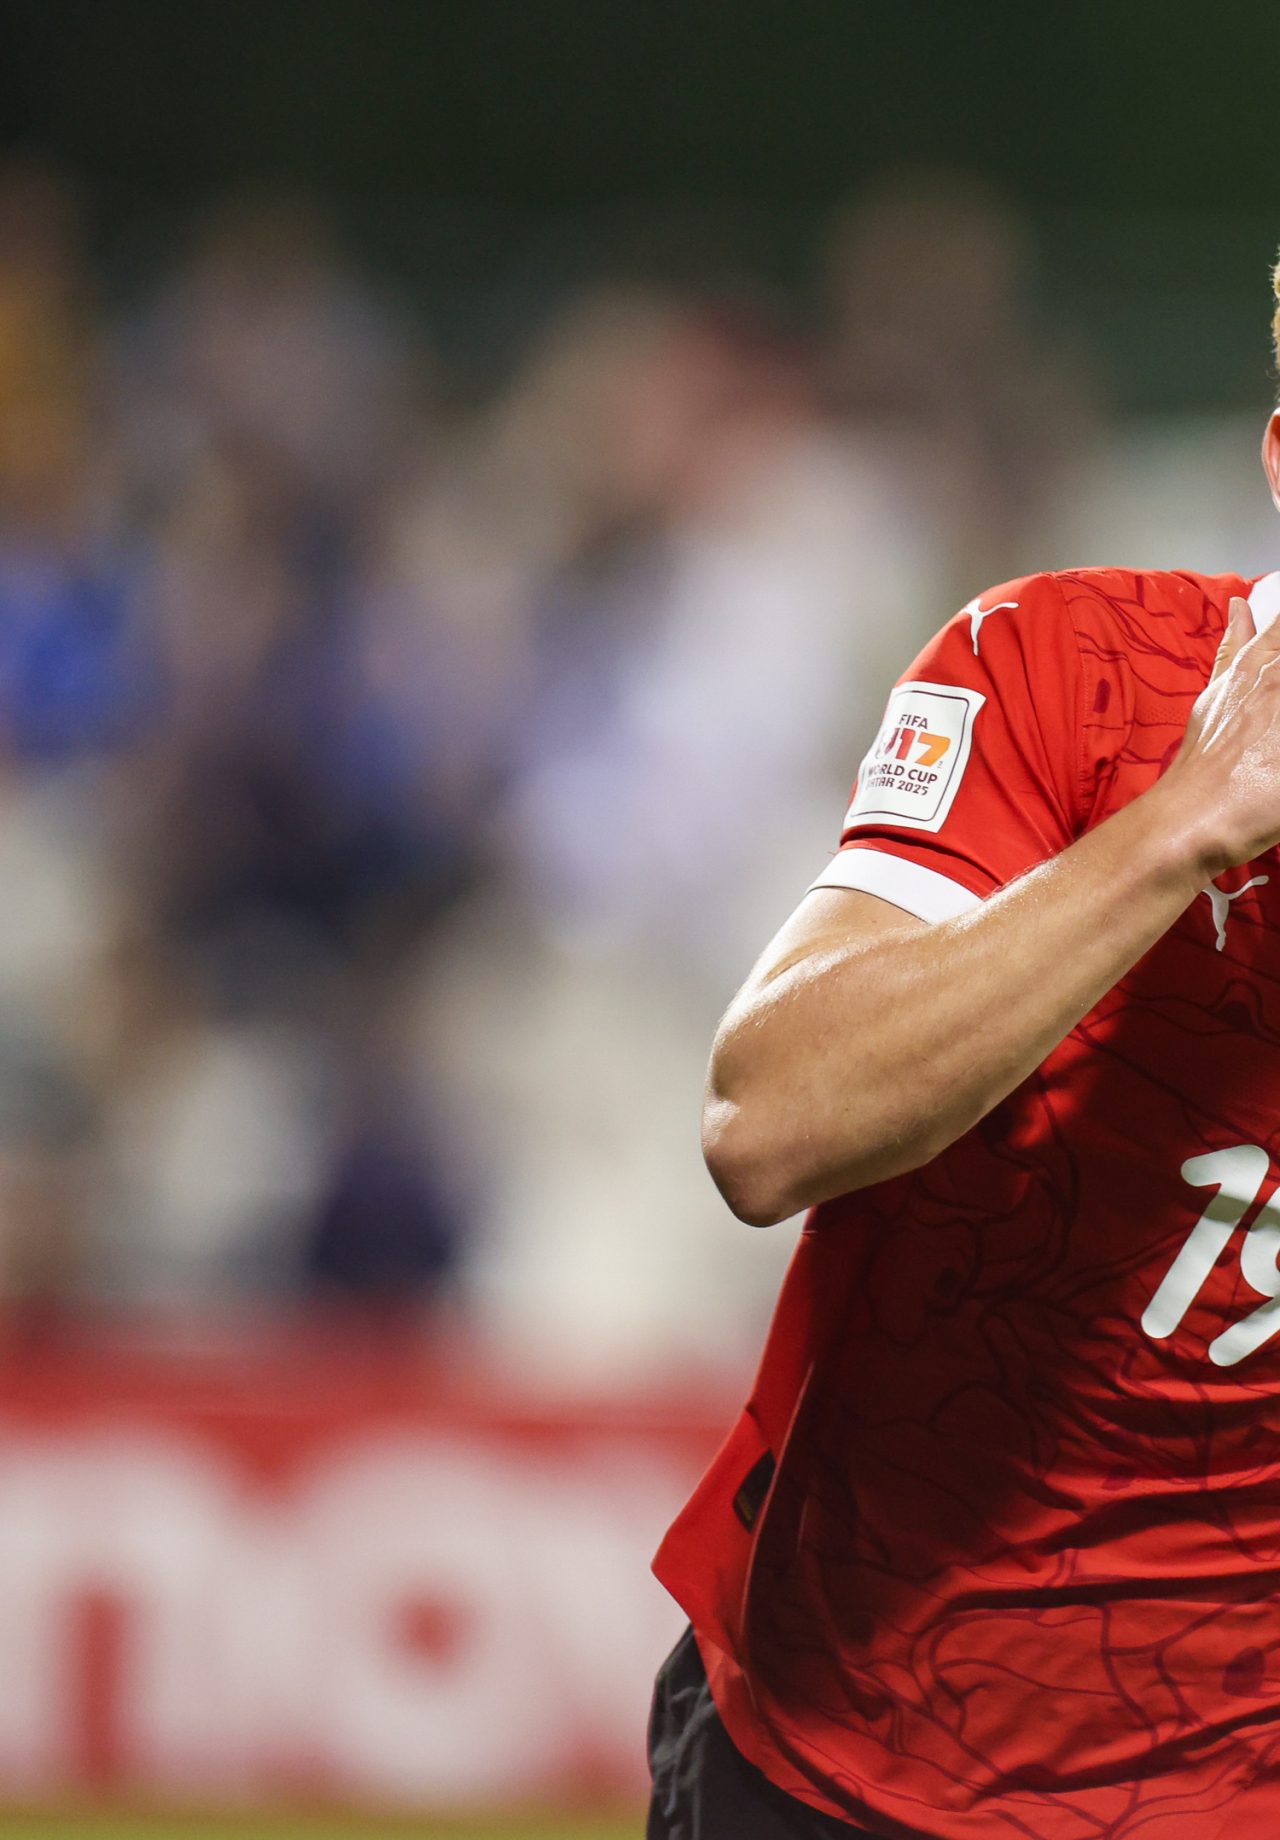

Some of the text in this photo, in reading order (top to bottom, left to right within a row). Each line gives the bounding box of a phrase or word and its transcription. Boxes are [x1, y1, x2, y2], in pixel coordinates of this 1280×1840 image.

[899, 714, 928, 729] FIFA
[908, 768, 938, 784] CUP
[897, 780, 929, 796] 2025
